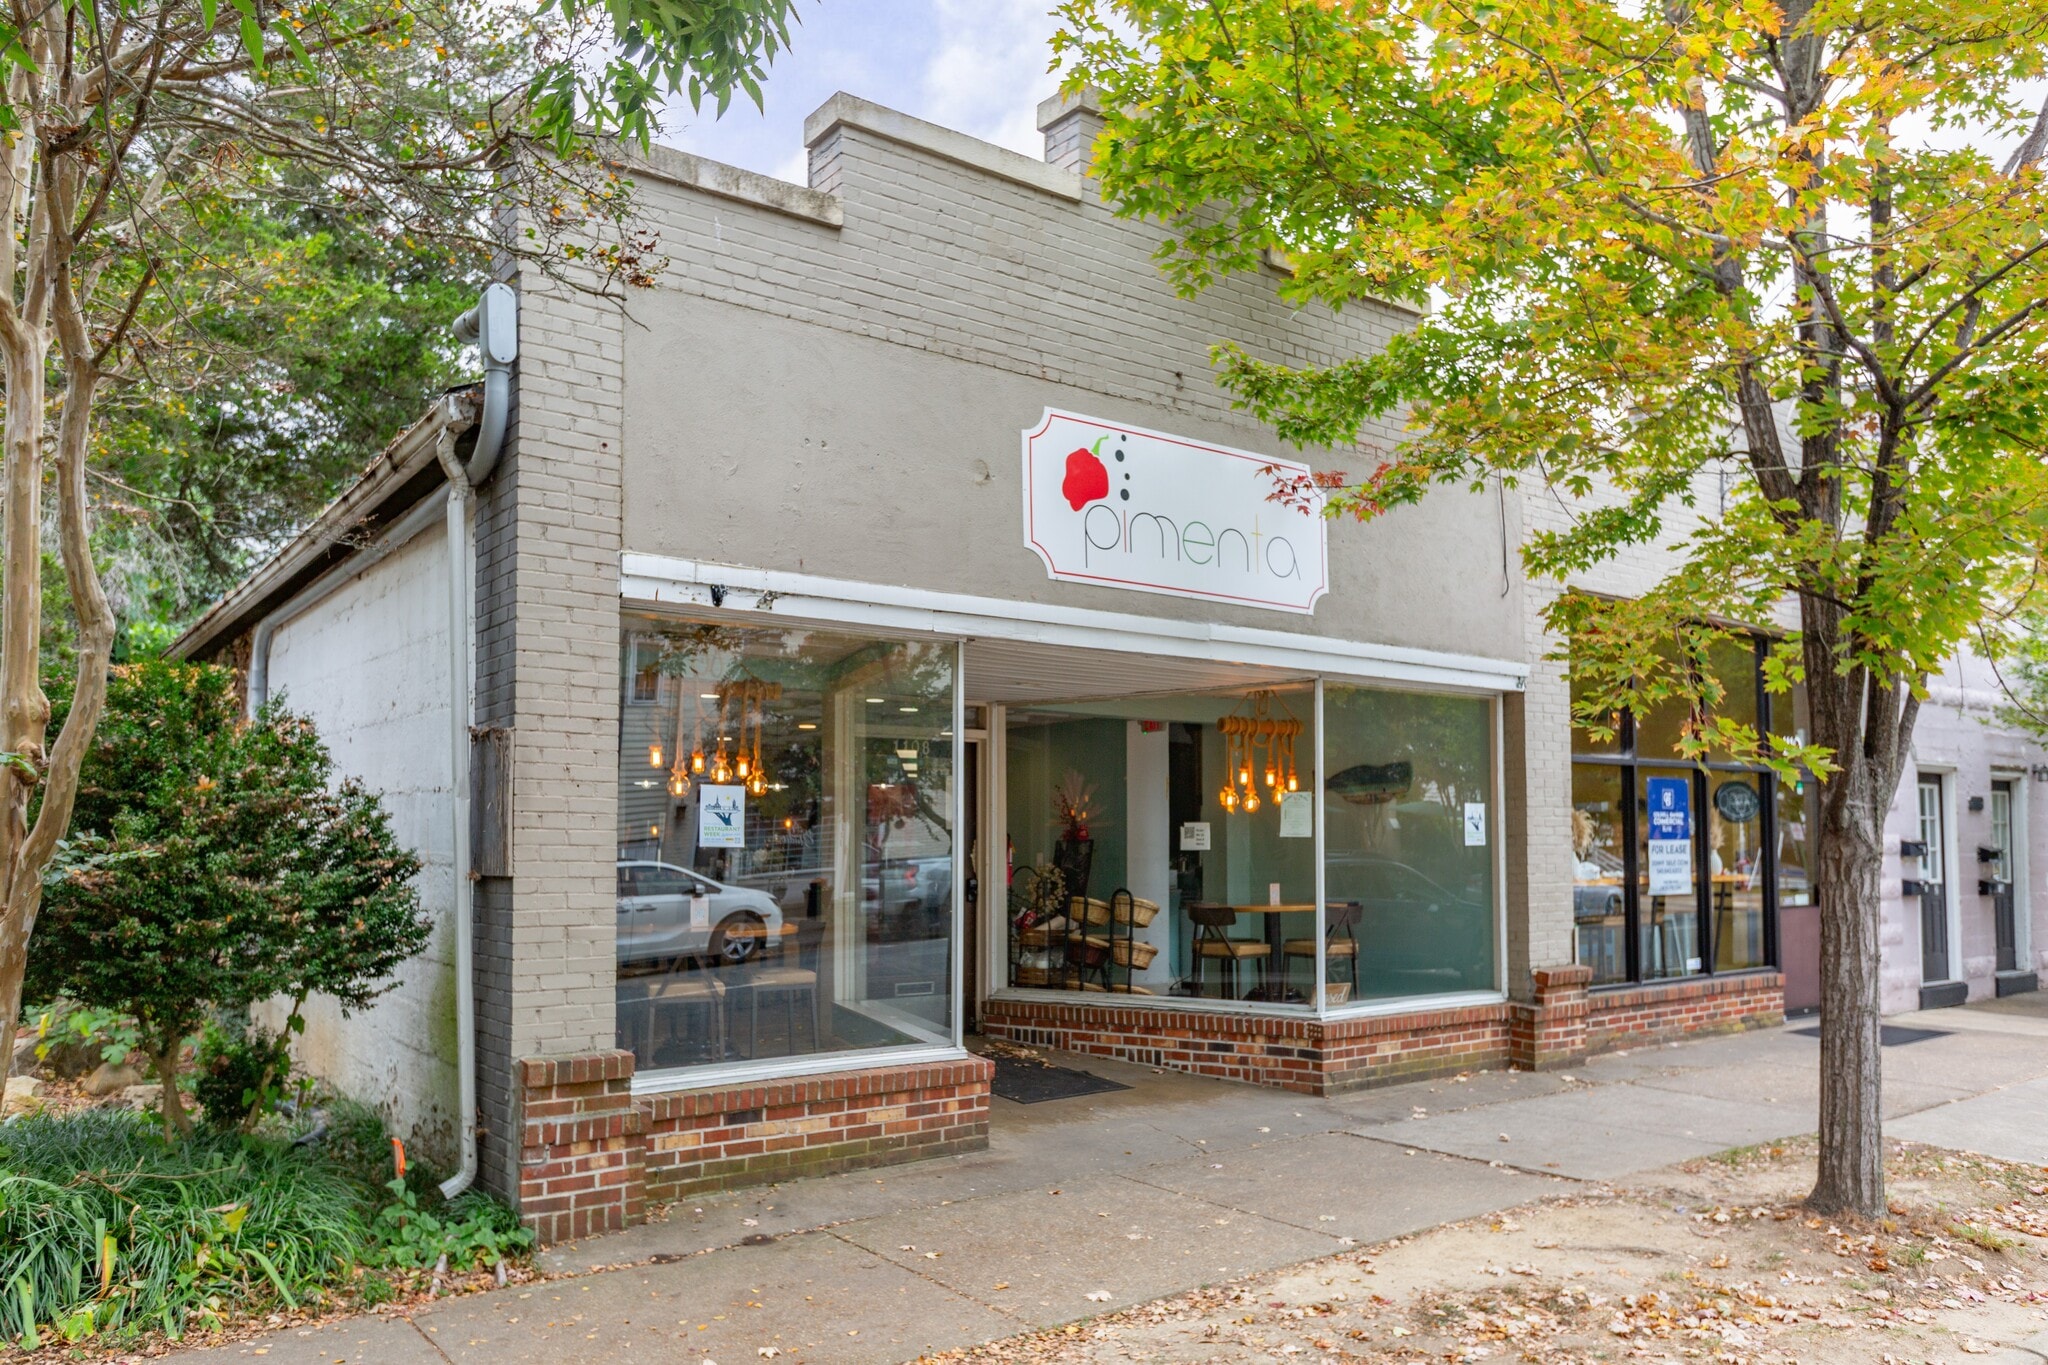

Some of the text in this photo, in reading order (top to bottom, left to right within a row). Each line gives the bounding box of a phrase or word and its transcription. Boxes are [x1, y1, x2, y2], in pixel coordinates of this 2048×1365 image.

[1085, 504, 1301, 580] pimenta
[1651, 844, 1687, 854] FOR LEASE
